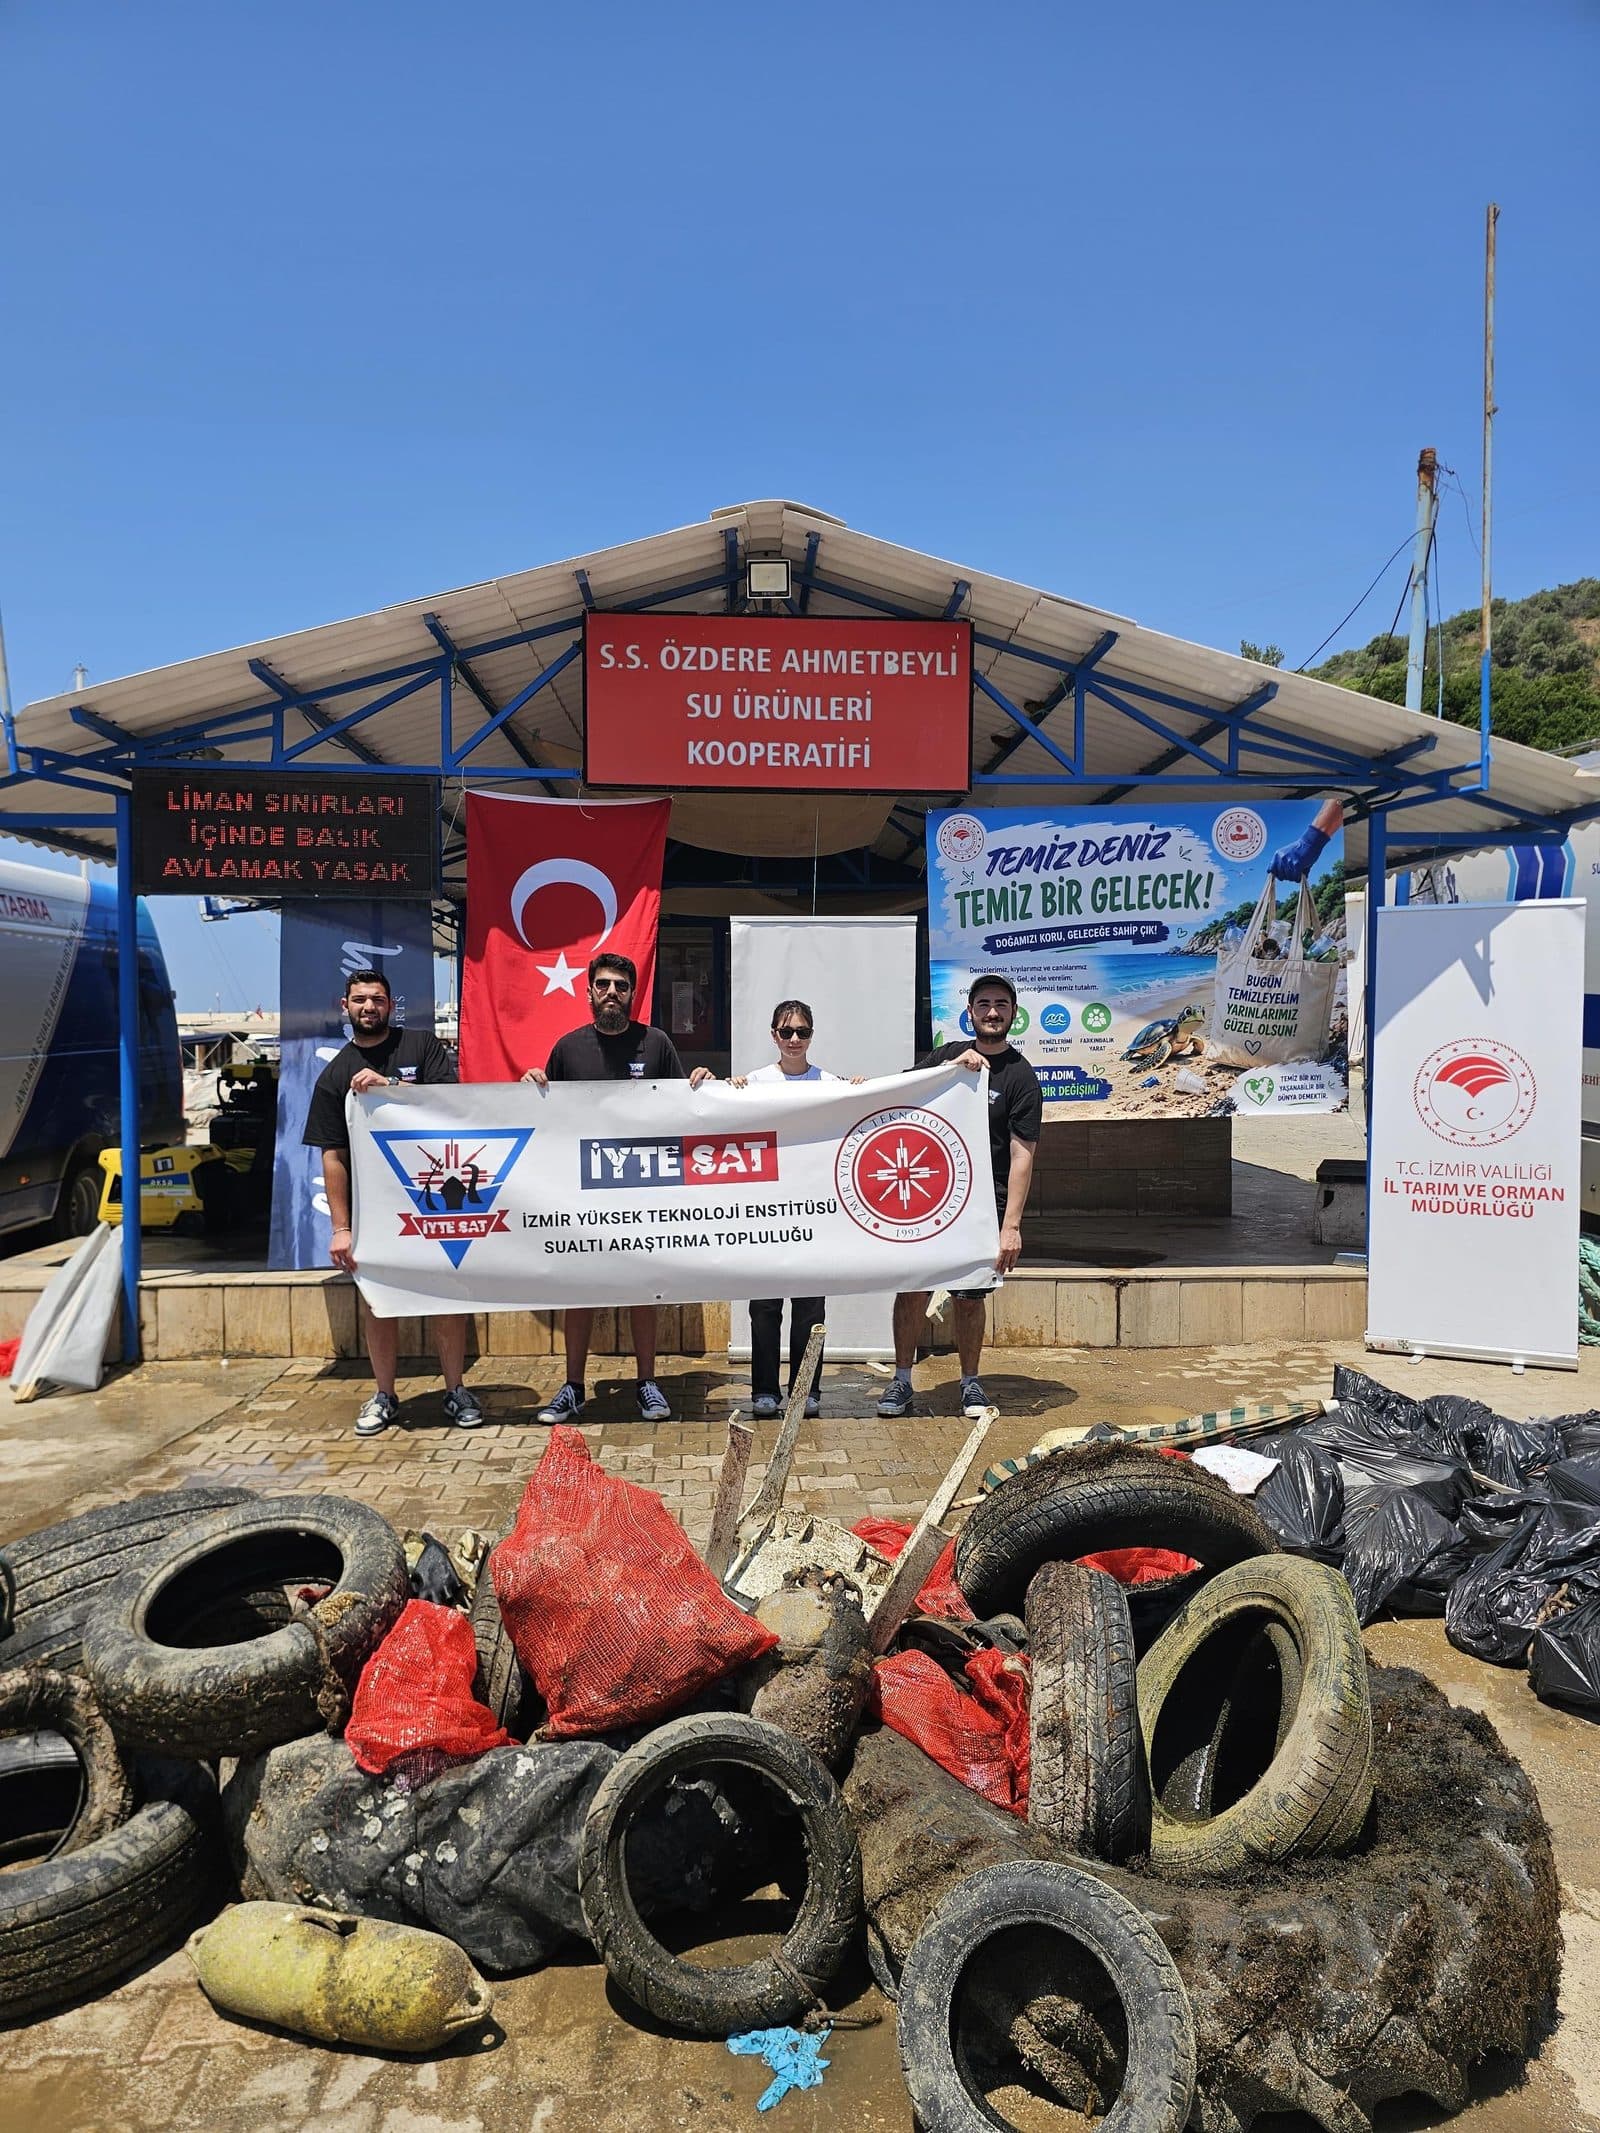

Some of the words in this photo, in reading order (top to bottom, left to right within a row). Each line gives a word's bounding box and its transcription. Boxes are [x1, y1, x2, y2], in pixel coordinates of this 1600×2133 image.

[600, 644, 649, 670] S.S.
[660, 638, 772, 673] ÖZDERE
[781, 645, 958, 676] AHMETBEYLİ
[687, 693, 722, 719] SU
[733, 688, 872, 721] ÜRÜNLERİ
[687, 737, 871, 768] KOOPERATİFİ
[168, 784, 252, 811] LİMAN
[191, 818, 284, 850] İÇİNDE
[296, 827, 382, 848] BALIK
[985, 834, 1078, 877] TEMİZ
[1077, 824, 1172, 868] DENİZ
[162, 857, 303, 879] AVLAMAK
[311, 860, 411, 882] YASAK
[954, 880, 1033, 928] TEMİZ
[1041, 875, 1083, 919] BİR
[1091, 869, 1214, 914] GELECEK!
[995, 933, 1038, 949] DOĞAMIZI
[1039, 933, 1066, 944] KORU,
[1067, 926, 1110, 940] GELECEĞE
[1112, 923, 1138, 937] SAHİP
[1140, 925, 1158, 938] ÇIK!
[1016, 975, 1029, 983] Gel,
[1246, 974, 1282, 988] BUGÜN
[1228, 987, 1300, 1005] TEMİZLEYELİM
[1227, 1003, 1298, 1020] YARINLARIMIZ
[1224, 1018, 1254, 1034] GÜZEL
[1258, 1023, 1298, 1037] OLSUN!
[1051, 1070, 1077, 1081] ADIM,
[1041, 1084, 1056, 1097] BİR
[1058, 1083, 1100, 1098] DEĞİŞİM!
[591, 1142, 680, 1179] İYTE
[691, 1141, 767, 1175] SAT
[1396, 1161, 1424, 1175] T.C.
[1428, 1160, 1477, 1177] İZMİR
[1480, 1163, 1552, 1181] VALİLİĞİ
[1384, 1177, 1399, 1194] İL
[1402, 1180, 1459, 1196] TARIM
[1463, 1183, 1487, 1198] VE
[1491, 1185, 1565, 1202] ORMAN
[523, 1210, 571, 1228] İZMİR
[577, 1209, 642, 1225] YÜKSEK
[647, 1203, 739, 1223] TEKNOLOJİ
[745, 1199, 837, 1218] ENSTİTÜSÜ
[1411, 1197, 1534, 1218] MÜDÜRLÜĞÜ
[423, 1220, 455, 1235] İYTE
[458, 1219, 488, 1233] SAT
[896, 1228, 921, 1238] 1992
[544, 1239, 602, 1254] SUALTI
[609, 1234, 710, 1253] ARAŞTIRMA
[715, 1226, 813, 1246] TOPLULUĞU
